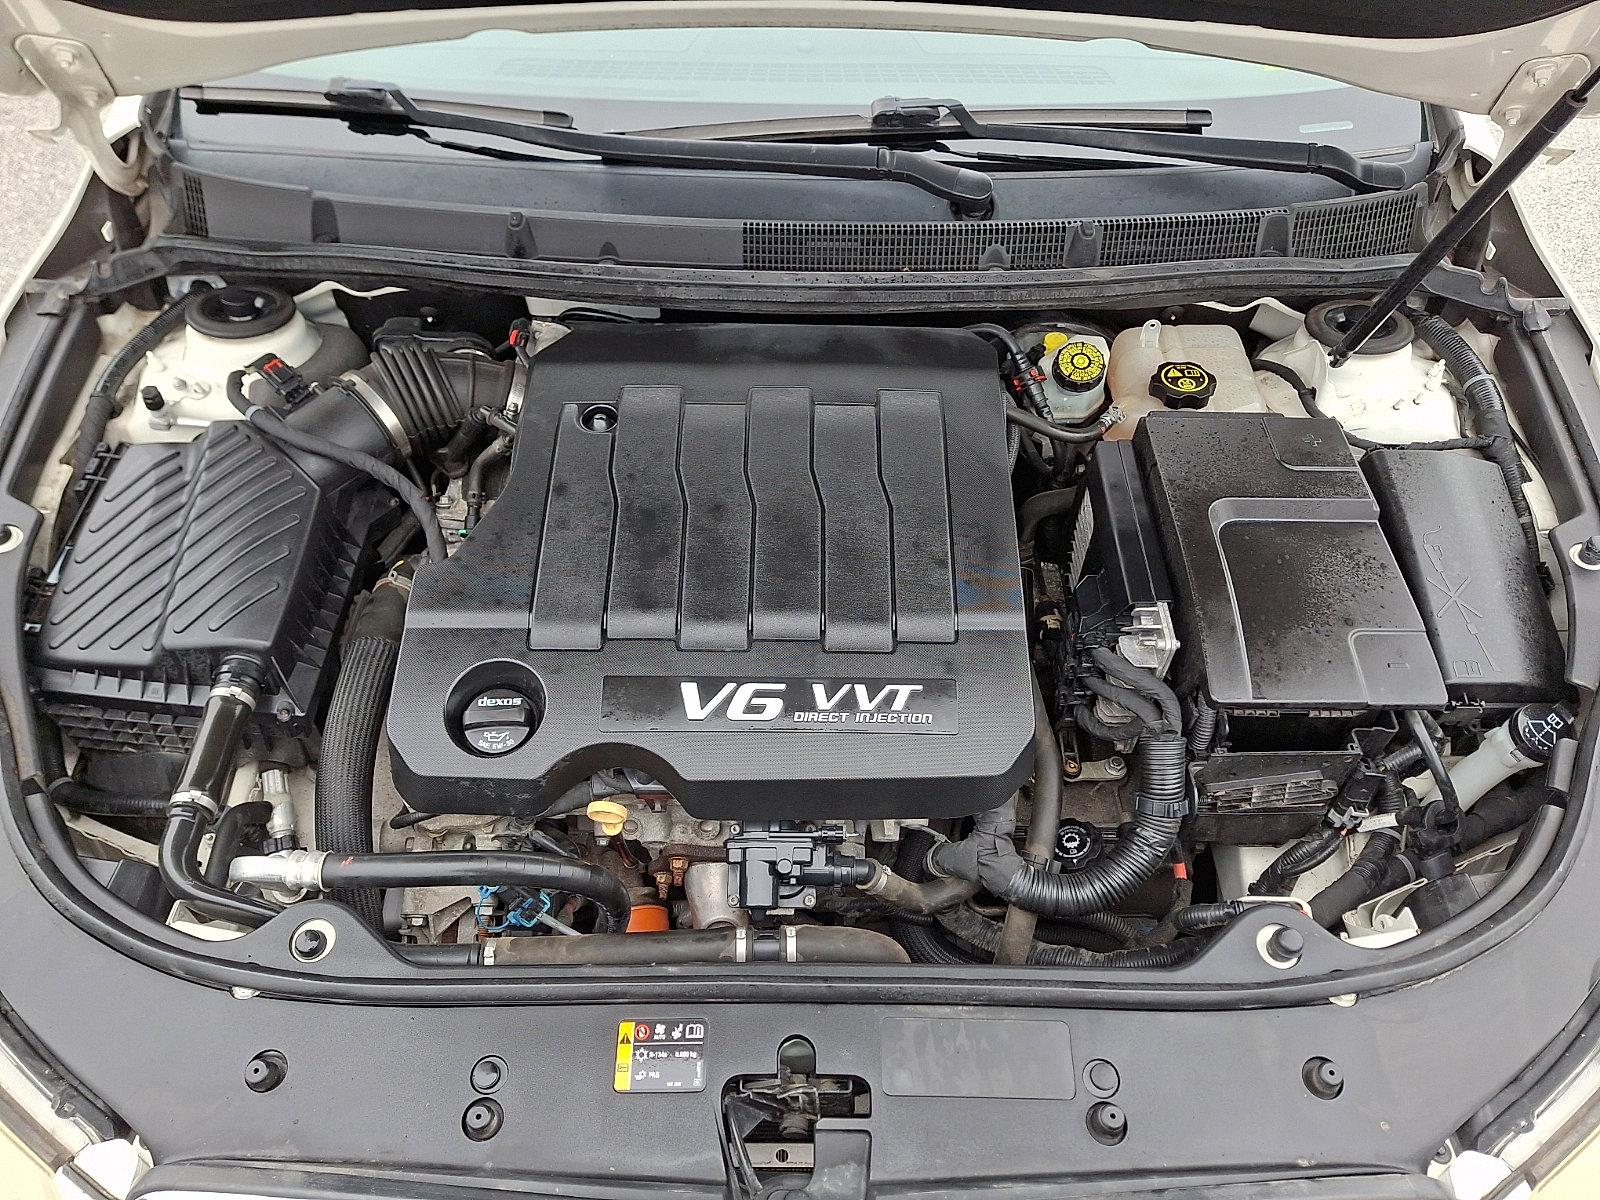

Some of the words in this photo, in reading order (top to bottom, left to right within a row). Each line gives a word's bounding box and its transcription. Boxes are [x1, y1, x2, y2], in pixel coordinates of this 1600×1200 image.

[477, 696, 523, 707] dexos
[680, 681, 787, 721] V6
[811, 683, 924, 711] VVT
[793, 711, 850, 723] DIRECT
[855, 712, 933, 724] INJECTION
[478, 740, 491, 749] SAE
[492, 739, 515, 749] 5W-30
